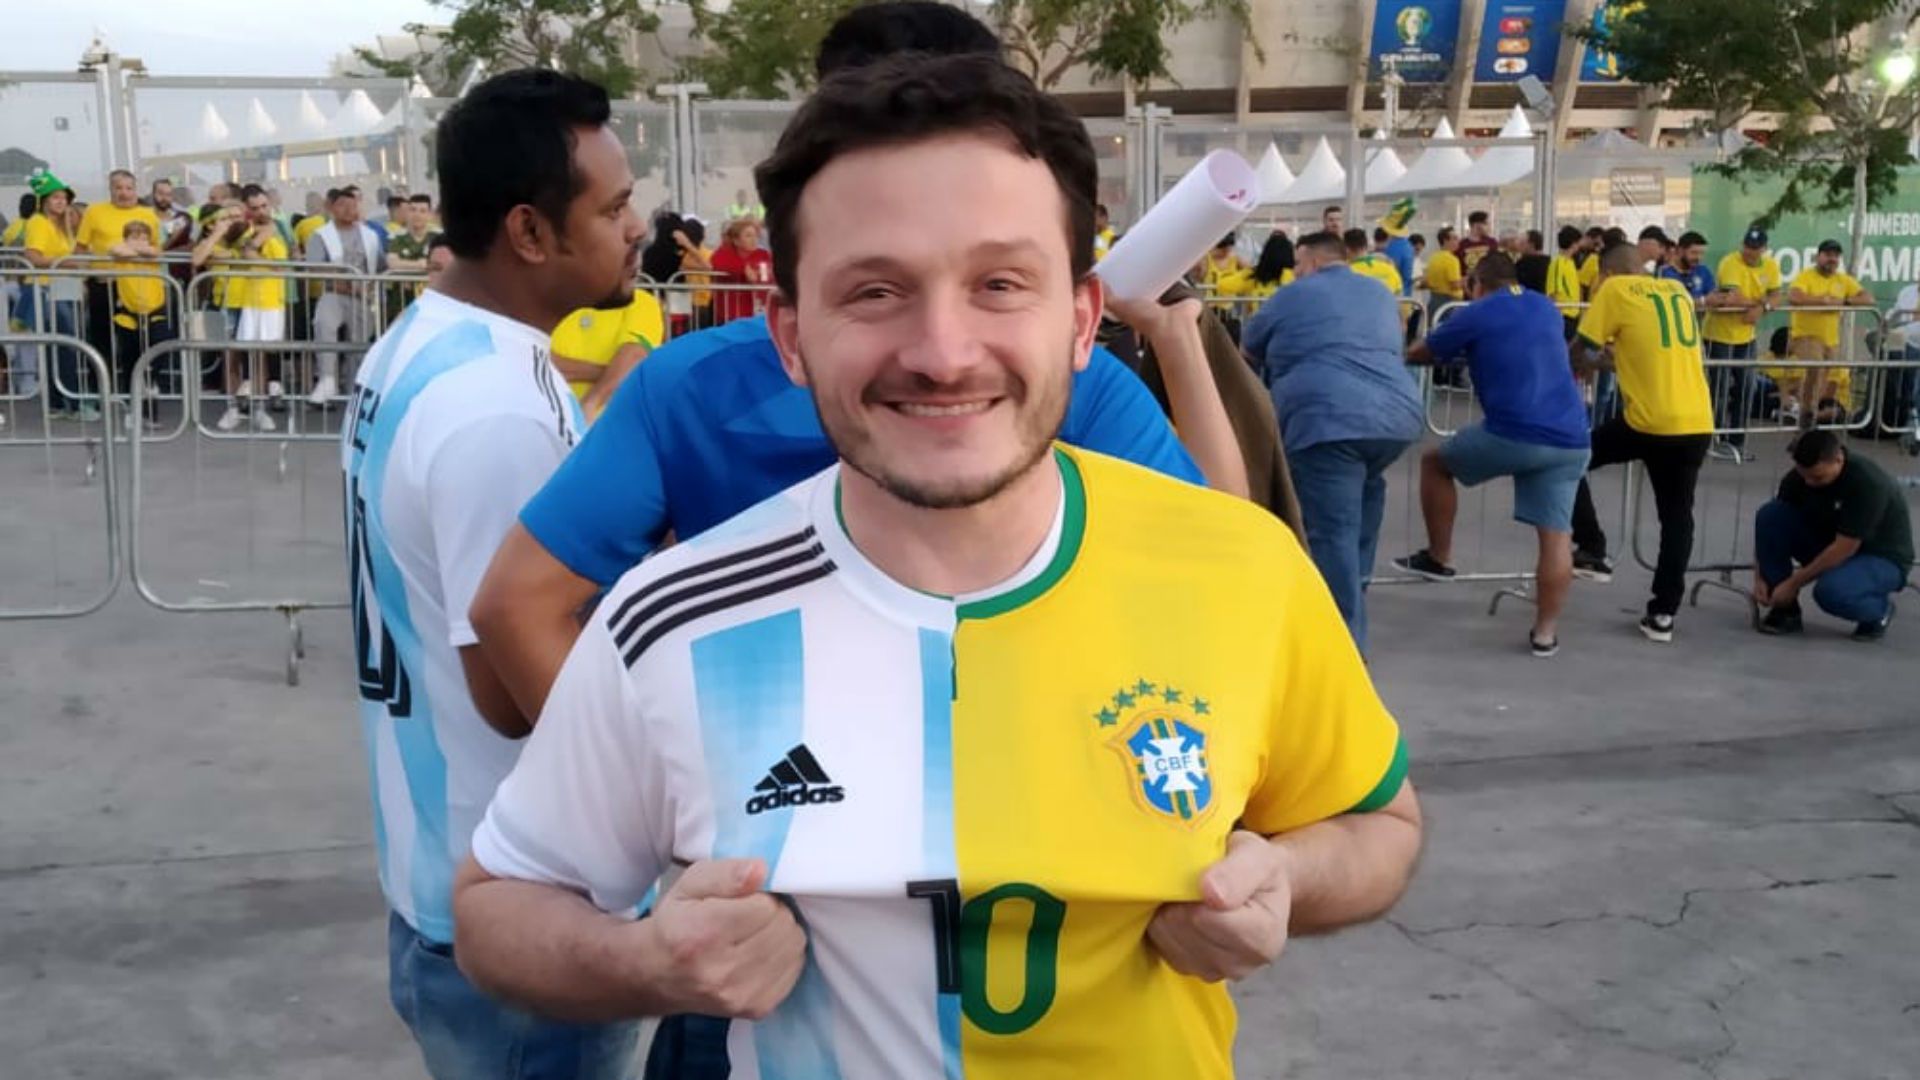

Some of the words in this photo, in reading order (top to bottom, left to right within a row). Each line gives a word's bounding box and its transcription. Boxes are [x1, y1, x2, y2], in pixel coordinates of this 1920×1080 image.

[1646, 293, 1697, 349] 10
[1154, 755, 1192, 773] CBF
[745, 783, 845, 815] adidas
[906, 878, 1067, 1035] 10
